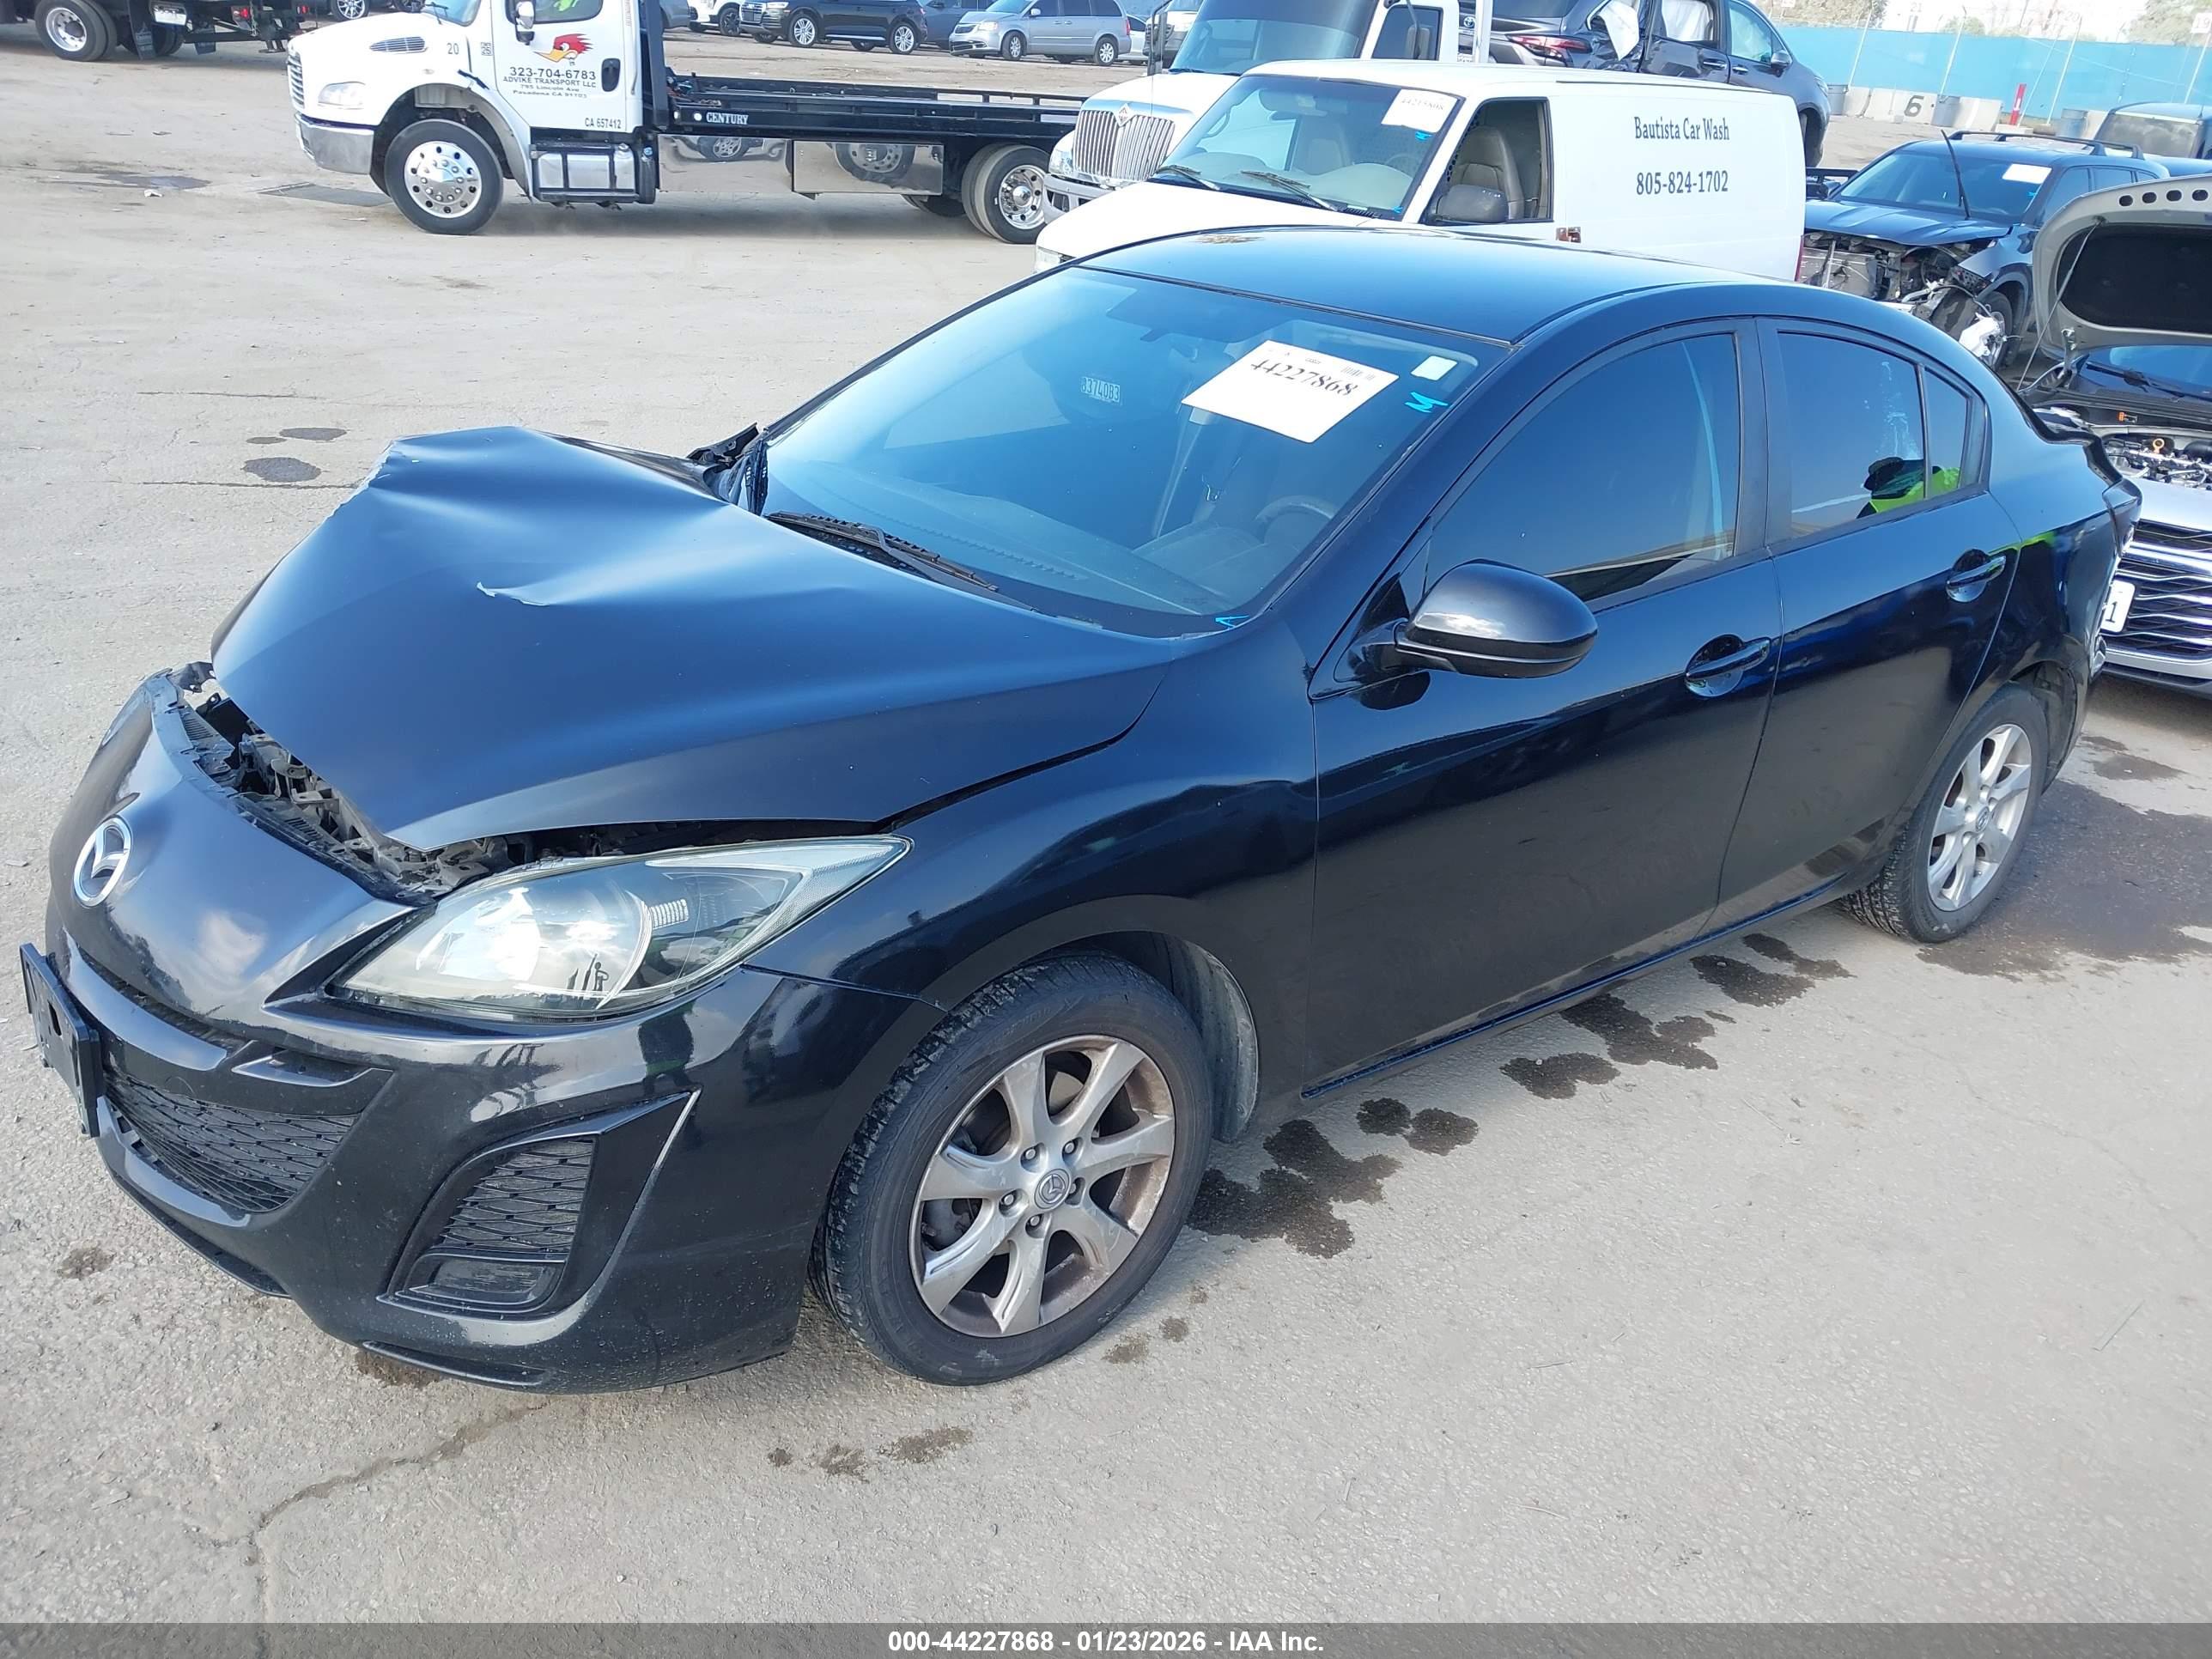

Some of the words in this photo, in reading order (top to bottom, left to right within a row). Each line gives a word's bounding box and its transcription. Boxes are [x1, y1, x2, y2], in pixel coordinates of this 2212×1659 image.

[447, 43, 459, 55] 20
[510, 66, 596, 81] 323-704-6783
[534, 77, 580, 86] TRANSPORT
[1904, 94, 1924, 118] 6
[585, 118, 595, 127] CA
[596, 118, 622, 129] 657412
[706, 112, 749, 125] CENTURY
[1634, 116, 1680, 140] Bautista
[1683, 118, 1701, 141] Car
[1702, 118, 1730, 141] Wash
[1637, 170, 1729, 196] 805-824-1702
[1250, 359, 1358, 396] 44227868
